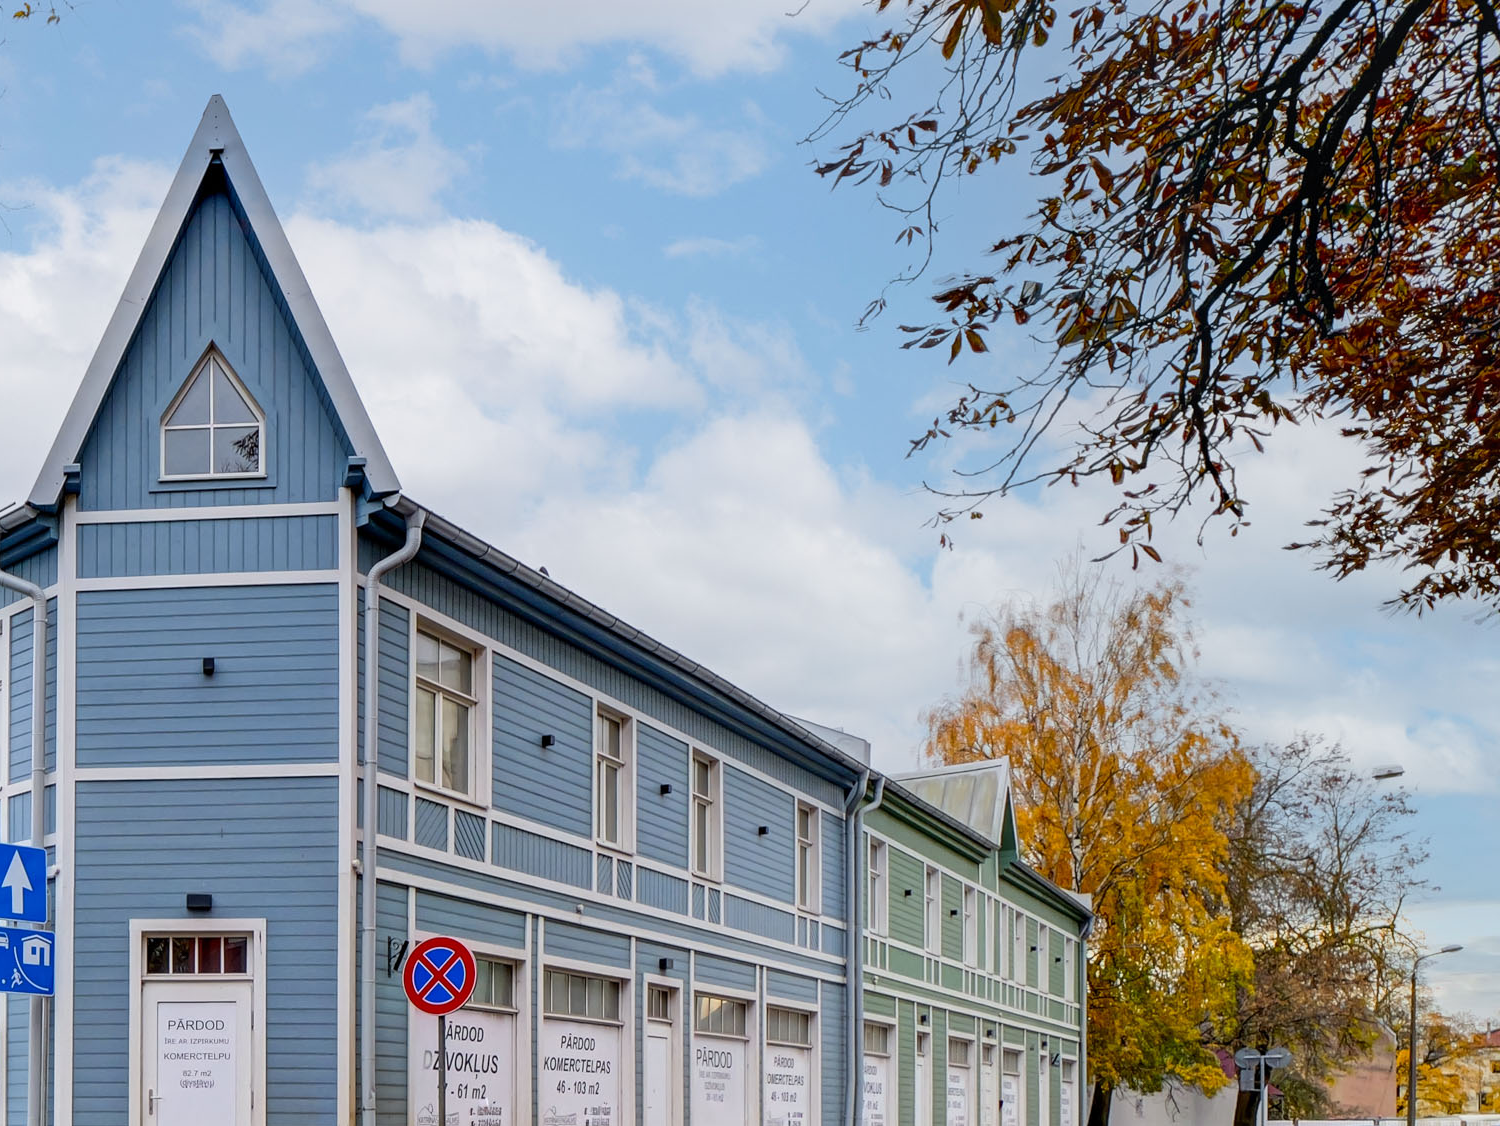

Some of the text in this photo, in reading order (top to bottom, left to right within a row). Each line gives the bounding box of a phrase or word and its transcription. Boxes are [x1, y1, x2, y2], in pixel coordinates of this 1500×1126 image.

[167, 1018, 225, 1031] PĀRDOD
[445, 1021, 484, 1042] ĀRDOD
[560, 1033, 596, 1052] PĀRDOD
[163, 1052, 231, 1061] KOMERCTELPU
[423, 1049, 499, 1080] DZVOKĻUS
[543, 1056, 611, 1075] KOMERCTELPAS
[696, 1046, 732, 1069] PĀRDOD
[556, 1079, 566, 1094] 46
[573, 1081, 587, 1095] 103
[588, 1081, 600, 1096] m2
[766, 1072, 805, 1087] OMERCTELPAS
[457, 1083, 469, 1099] 61
[471, 1083, 487, 1100] m2
